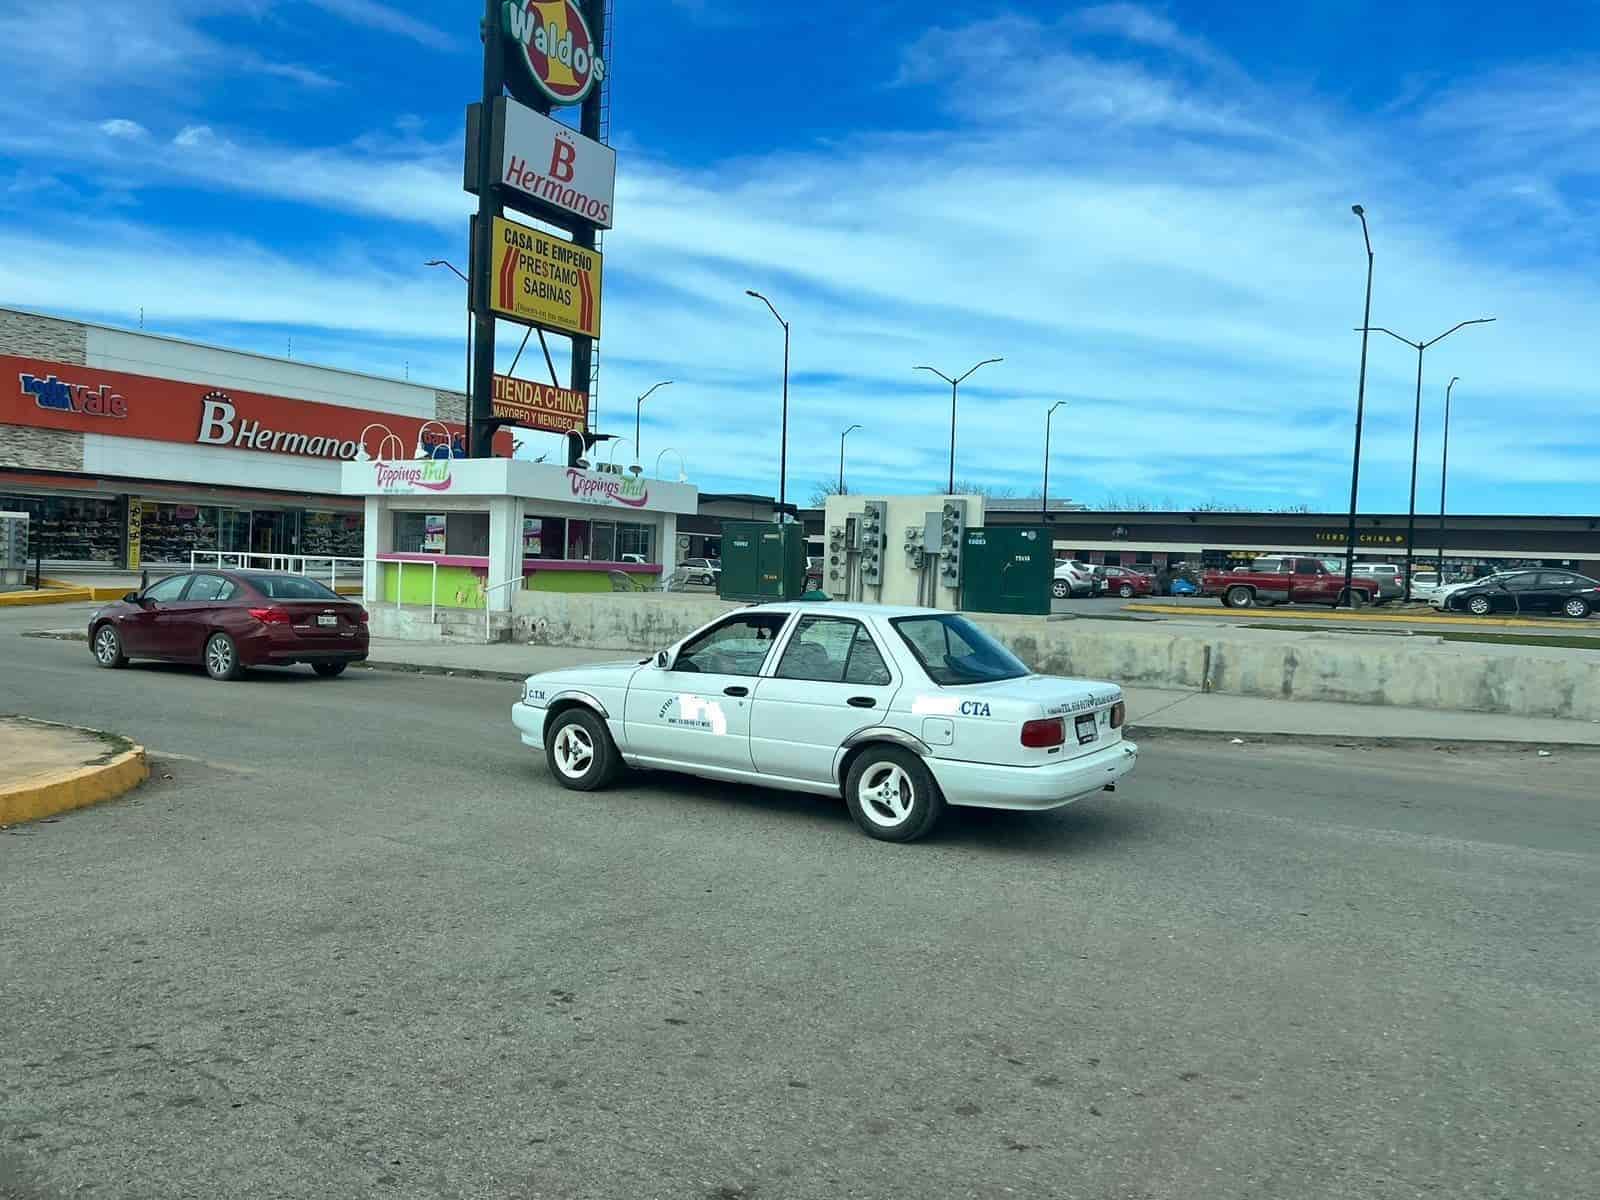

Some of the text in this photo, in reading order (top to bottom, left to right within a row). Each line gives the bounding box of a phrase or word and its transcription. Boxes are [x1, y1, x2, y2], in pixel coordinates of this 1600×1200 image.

[510, 2, 605, 80] Waldo's
[550, 137, 576, 183] B
[505, 155, 610, 221] Hermanos
[504, 228, 592, 272] CASA DE EMPEÑO
[519, 254, 578, 287] PRESTAMO
[523, 277, 572, 306] SABINAS
[494, 377, 585, 414] TIENDA CHINA
[197, 398, 236, 445] B
[531, 412, 537, 424] Y
[537, 415, 573, 430] MENUDEO
[566, 469, 620, 495] Toppings
[960, 700, 992, 718] CTA
